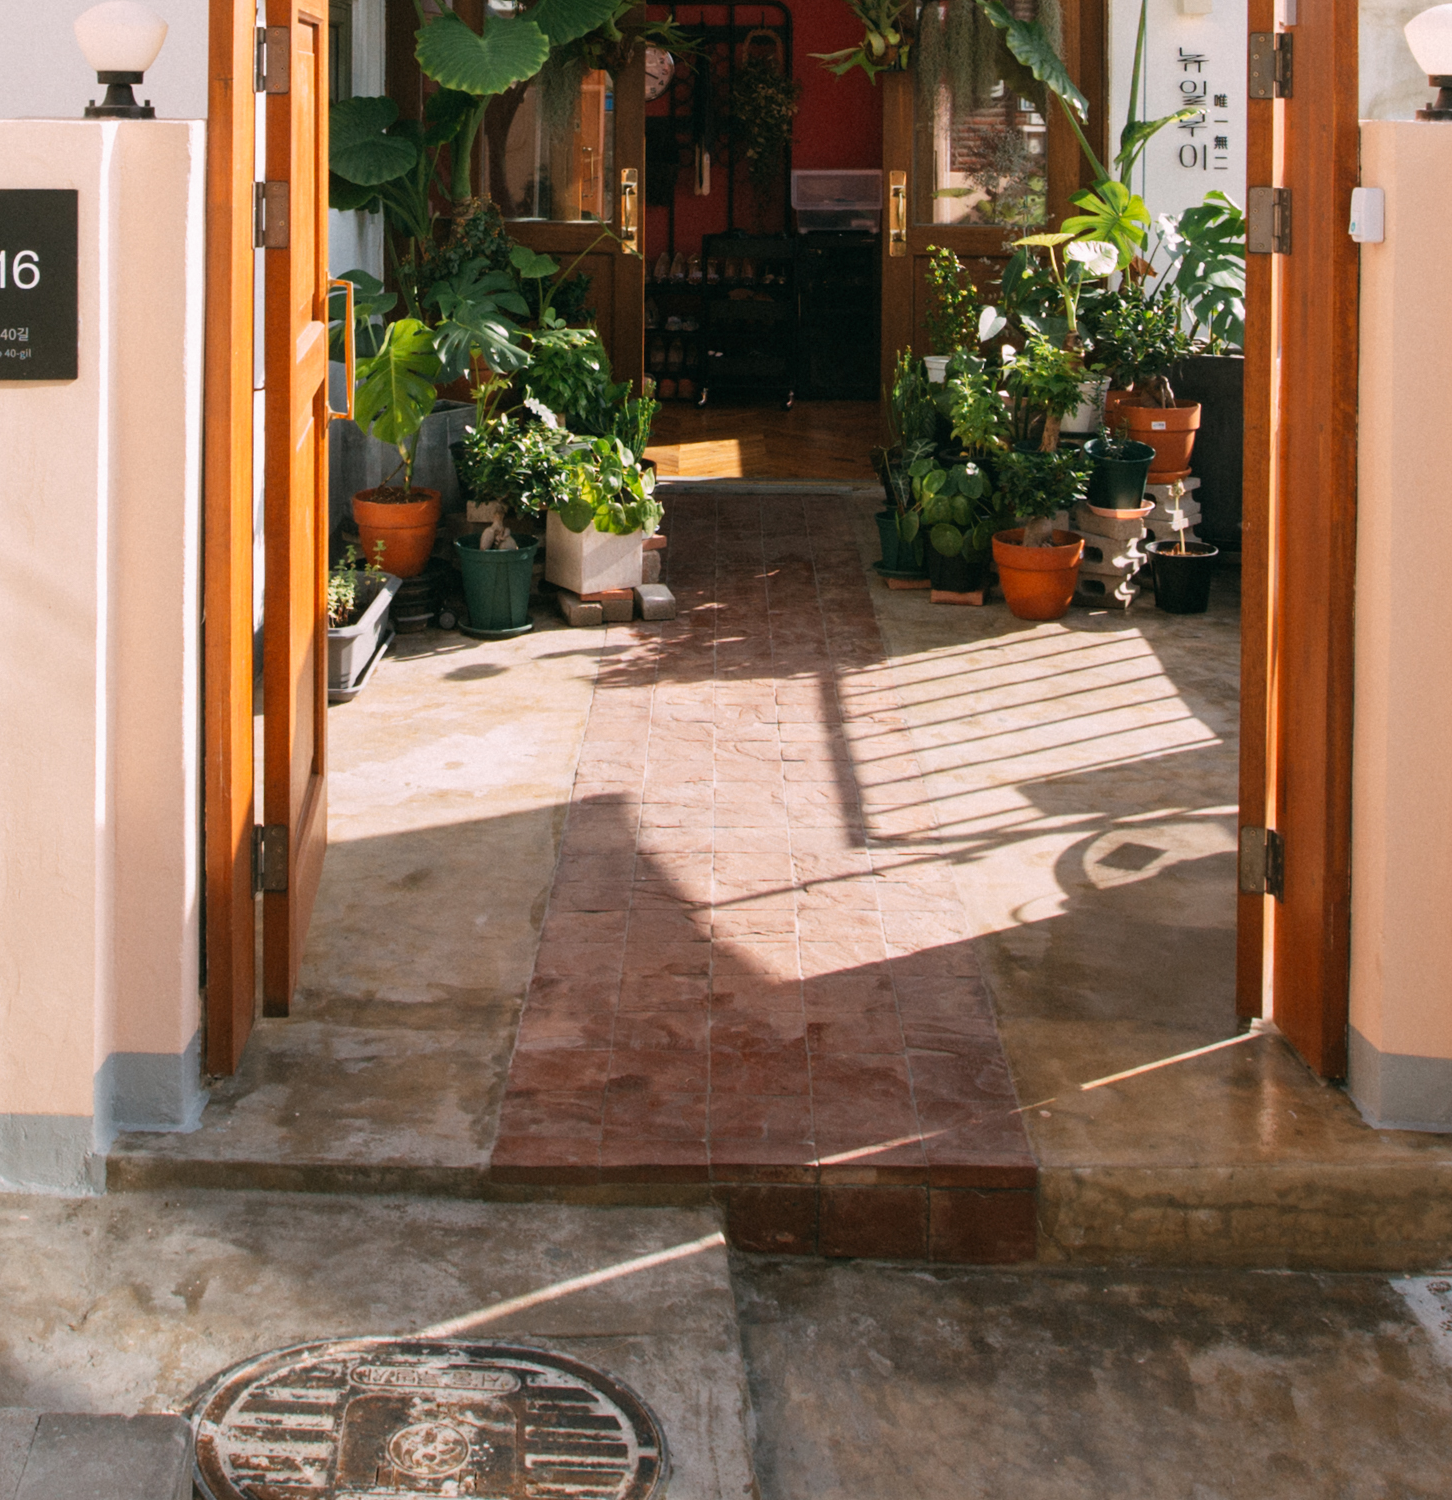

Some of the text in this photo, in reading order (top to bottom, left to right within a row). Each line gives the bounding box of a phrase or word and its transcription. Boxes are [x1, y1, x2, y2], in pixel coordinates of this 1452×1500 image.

[1177, 46, 1210, 171] 뉴일무이
[1213, 93, 1229, 170] 唯一無二
[4, 348, 32, 361] 40-gil
